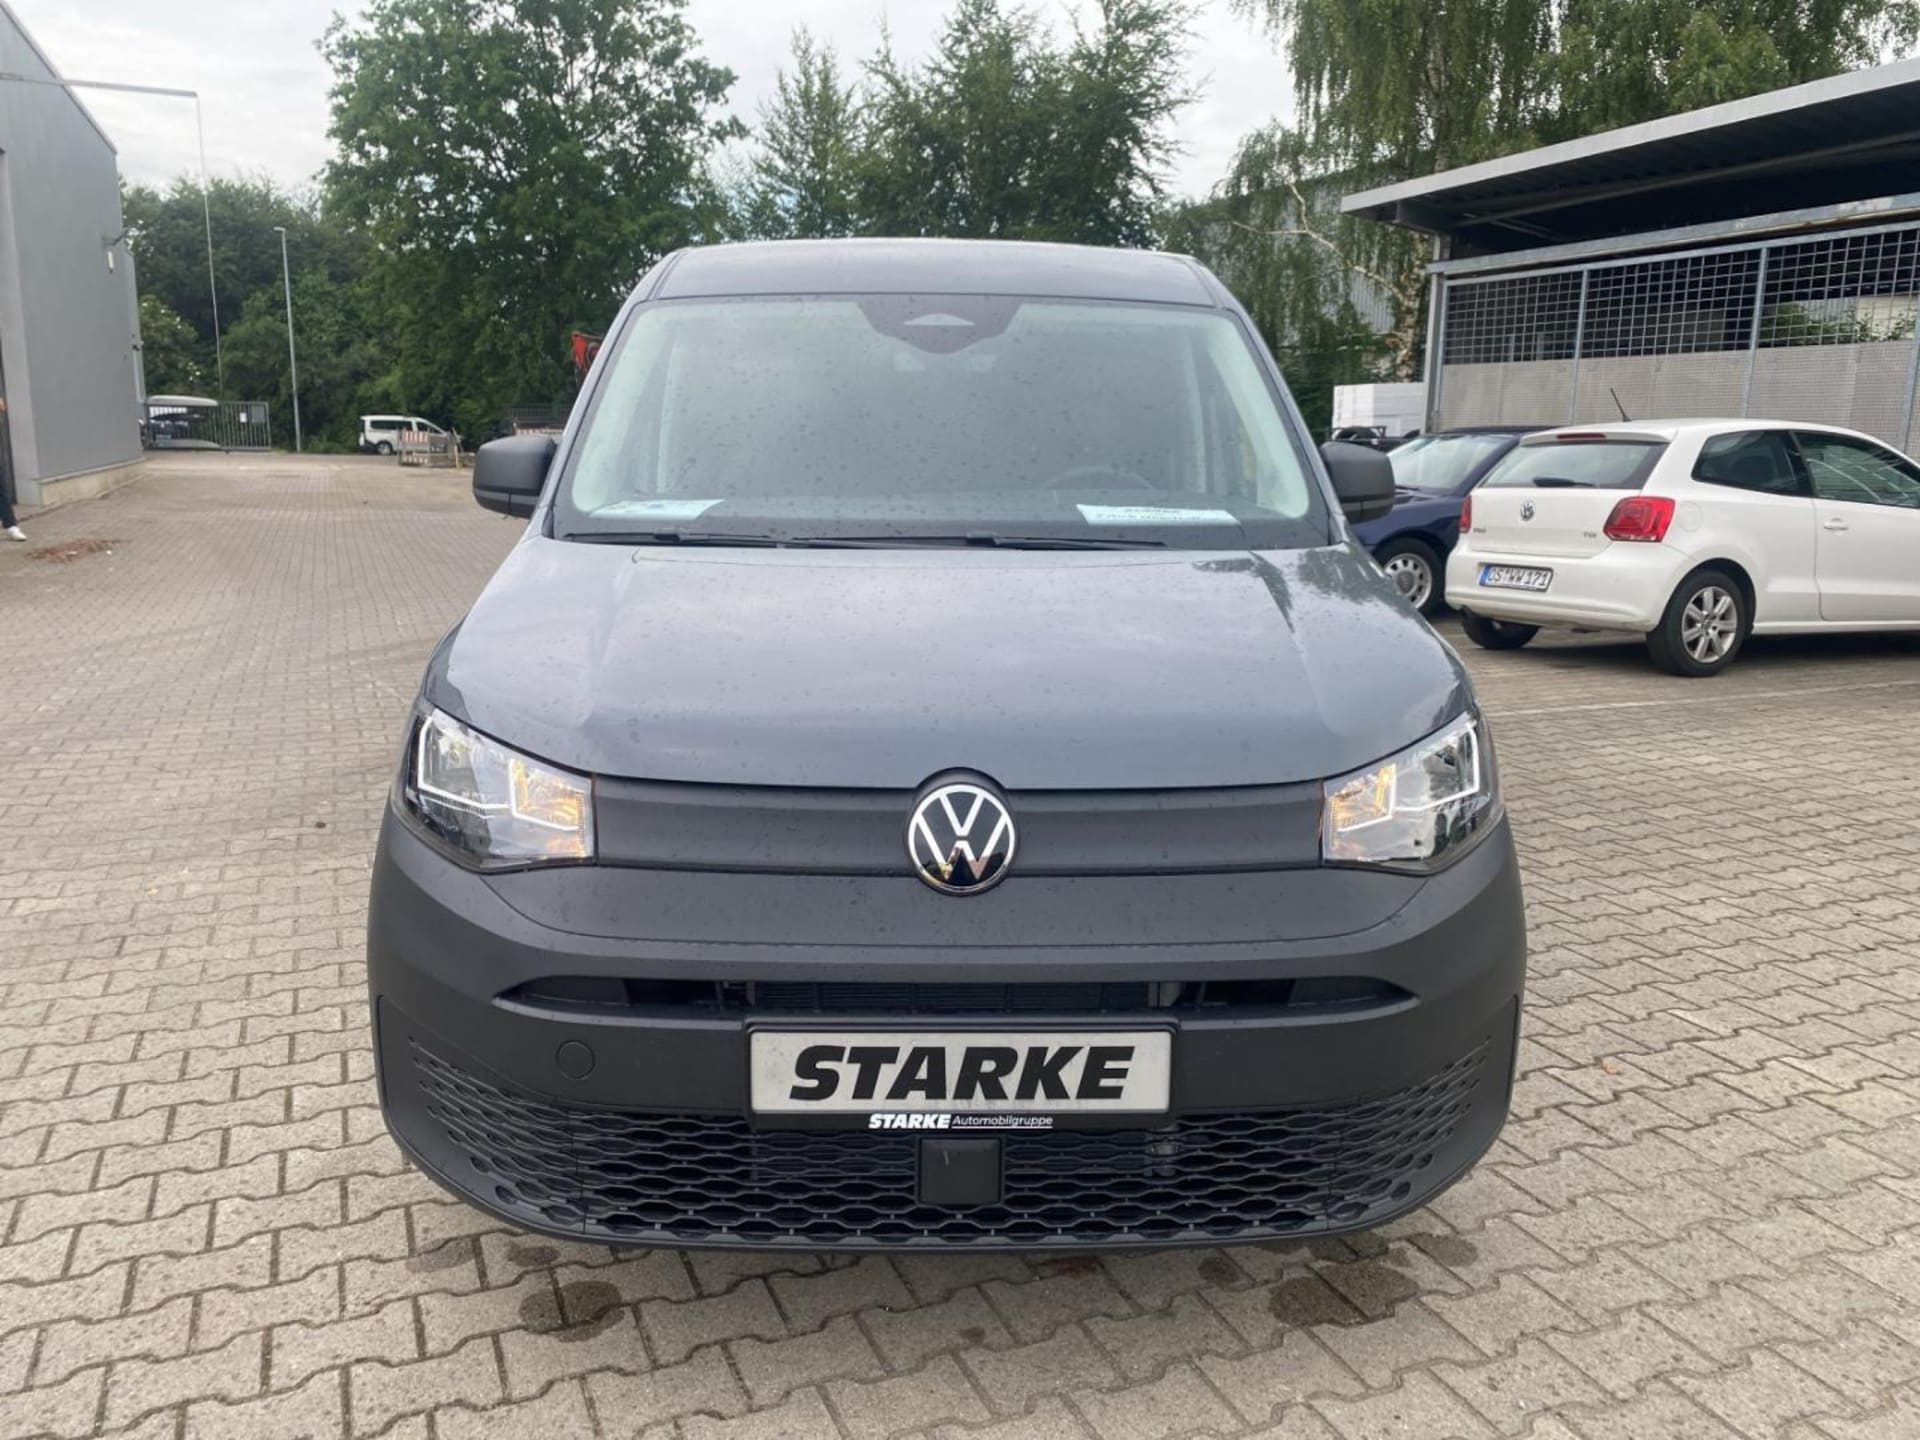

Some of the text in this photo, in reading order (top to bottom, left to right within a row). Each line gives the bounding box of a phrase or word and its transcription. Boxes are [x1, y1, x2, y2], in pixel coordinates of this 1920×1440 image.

[789, 1045, 1135, 1101] STARKE
[868, 1113, 1053, 1129] STARKE Automobilgruppe
